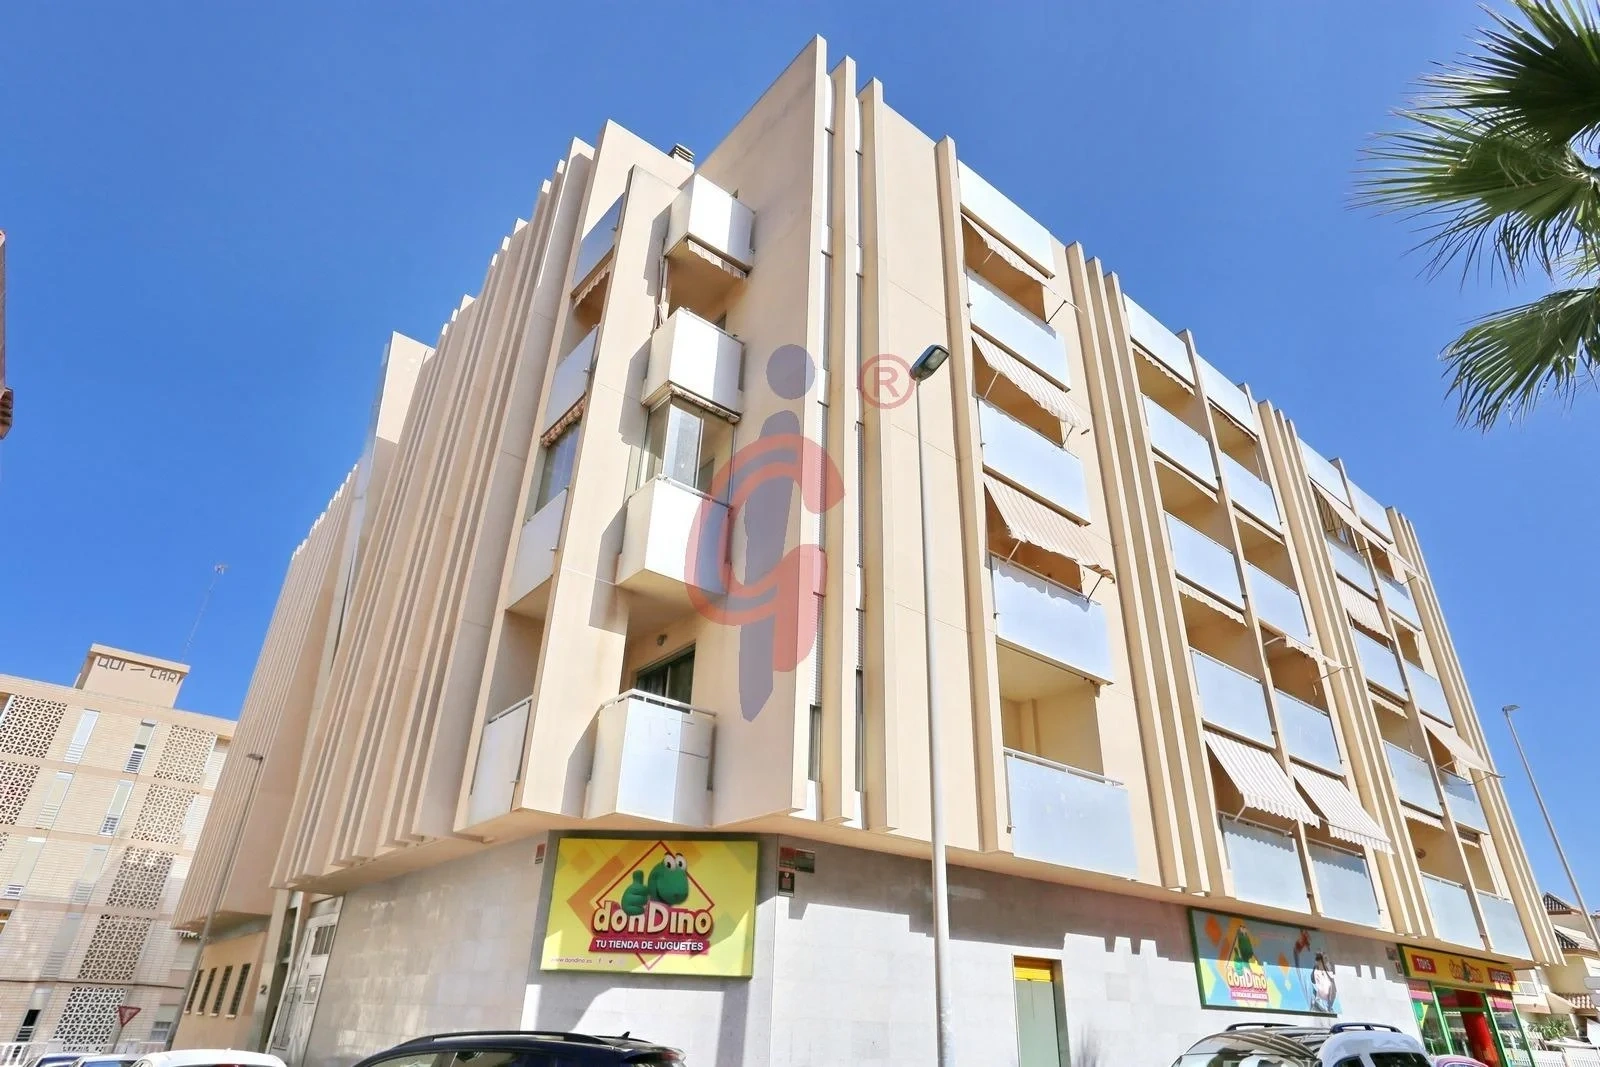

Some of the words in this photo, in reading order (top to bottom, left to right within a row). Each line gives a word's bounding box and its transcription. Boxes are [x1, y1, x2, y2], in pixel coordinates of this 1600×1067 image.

[593, 901, 712, 935] donDino
[596, 940, 607, 948] TU
[608, 940, 639, 949] TIENDA
[641, 942, 653, 950] DE
[654, 942, 704, 951] JUGUETES
[260, 984, 267, 995] 2
